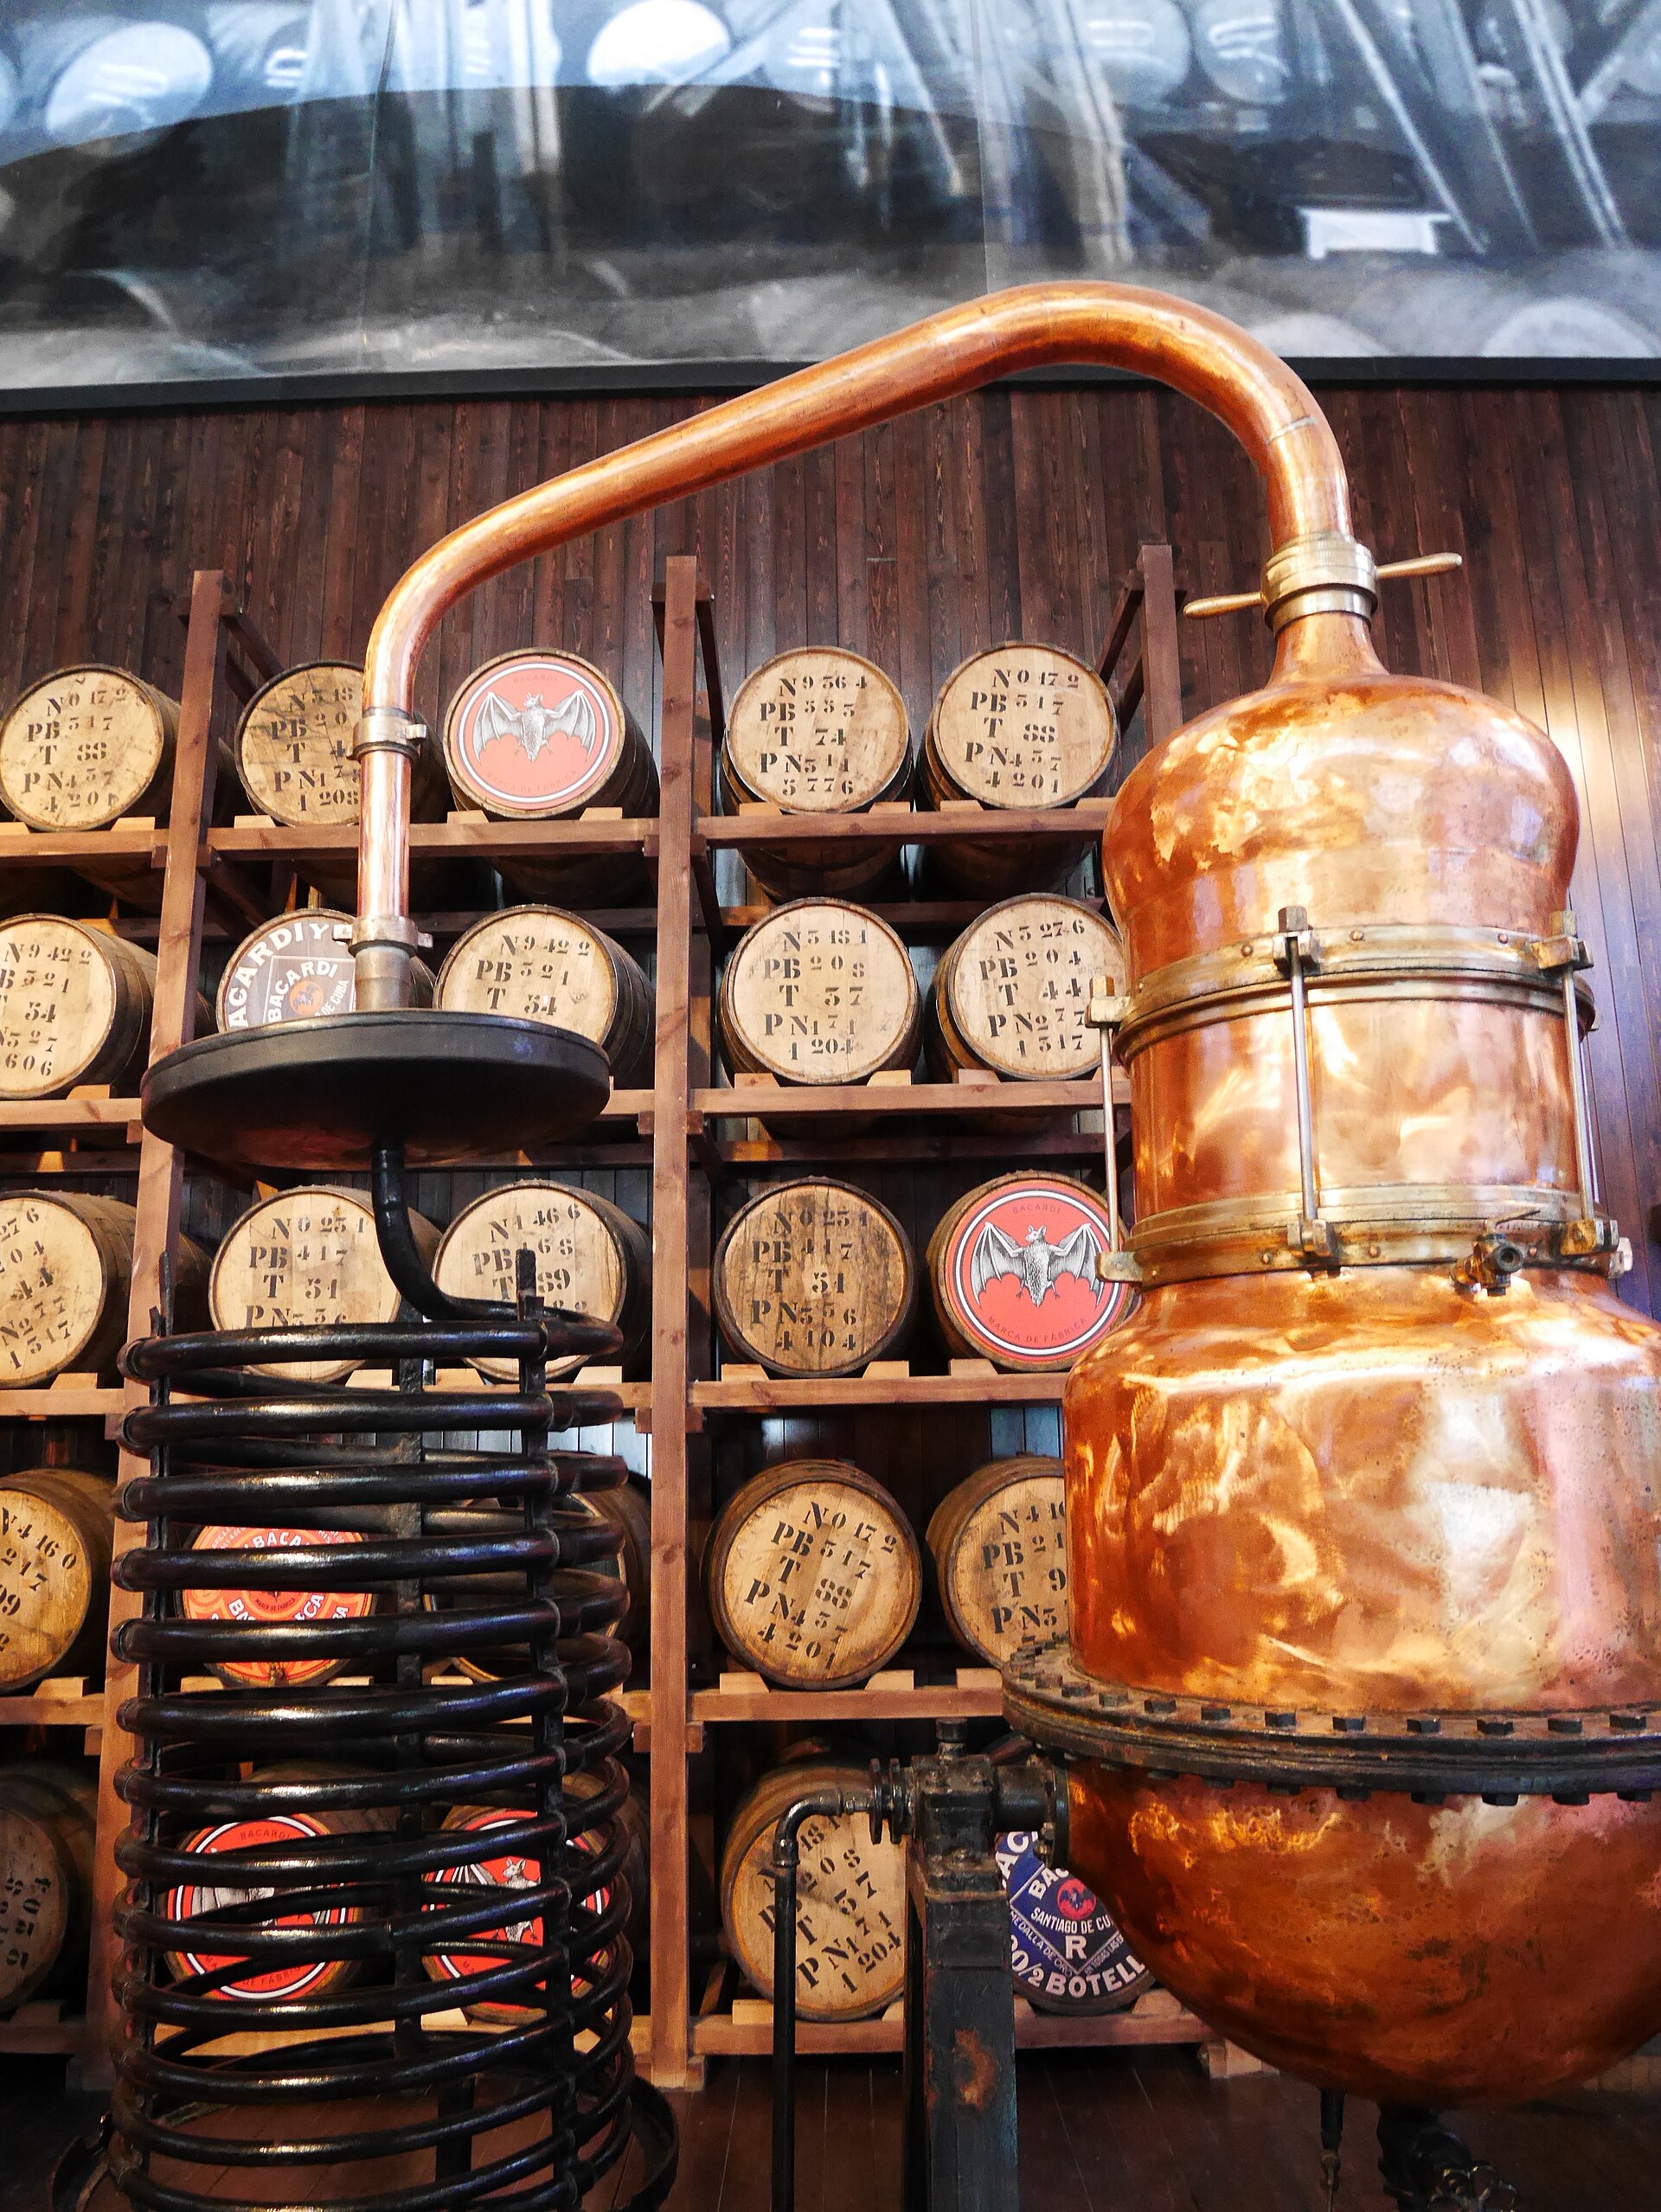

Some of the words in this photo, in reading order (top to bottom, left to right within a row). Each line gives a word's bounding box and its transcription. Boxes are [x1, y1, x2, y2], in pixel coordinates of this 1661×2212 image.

[774, 727, 794, 747] T
[984, 717, 1004, 739] T
[40, 745, 57, 765] T
[268, 960, 338, 1023] BACARDI
[486, 987, 506, 1010] T
[779, 984, 799, 1007] T
[998, 982, 1019, 1006] T
[1012, 1203, 1062, 1215] BACARDI
[263, 1273, 284, 1298] T
[493, 1275, 514, 1300] T
[767, 1268, 789, 1293] T
[252, 1531, 311, 1549] BACA
[779, 1555, 801, 1584] T
[1003, 1571, 1025, 1598] T
[1030, 1906, 1078, 1934] SANTIAGO
[1081, 1919, 1095, 1934] DE
[1096, 1914, 1114, 1932] CU
[1065, 1935, 1087, 1960] R
[1045, 1954, 1146, 1998] BOTELL
